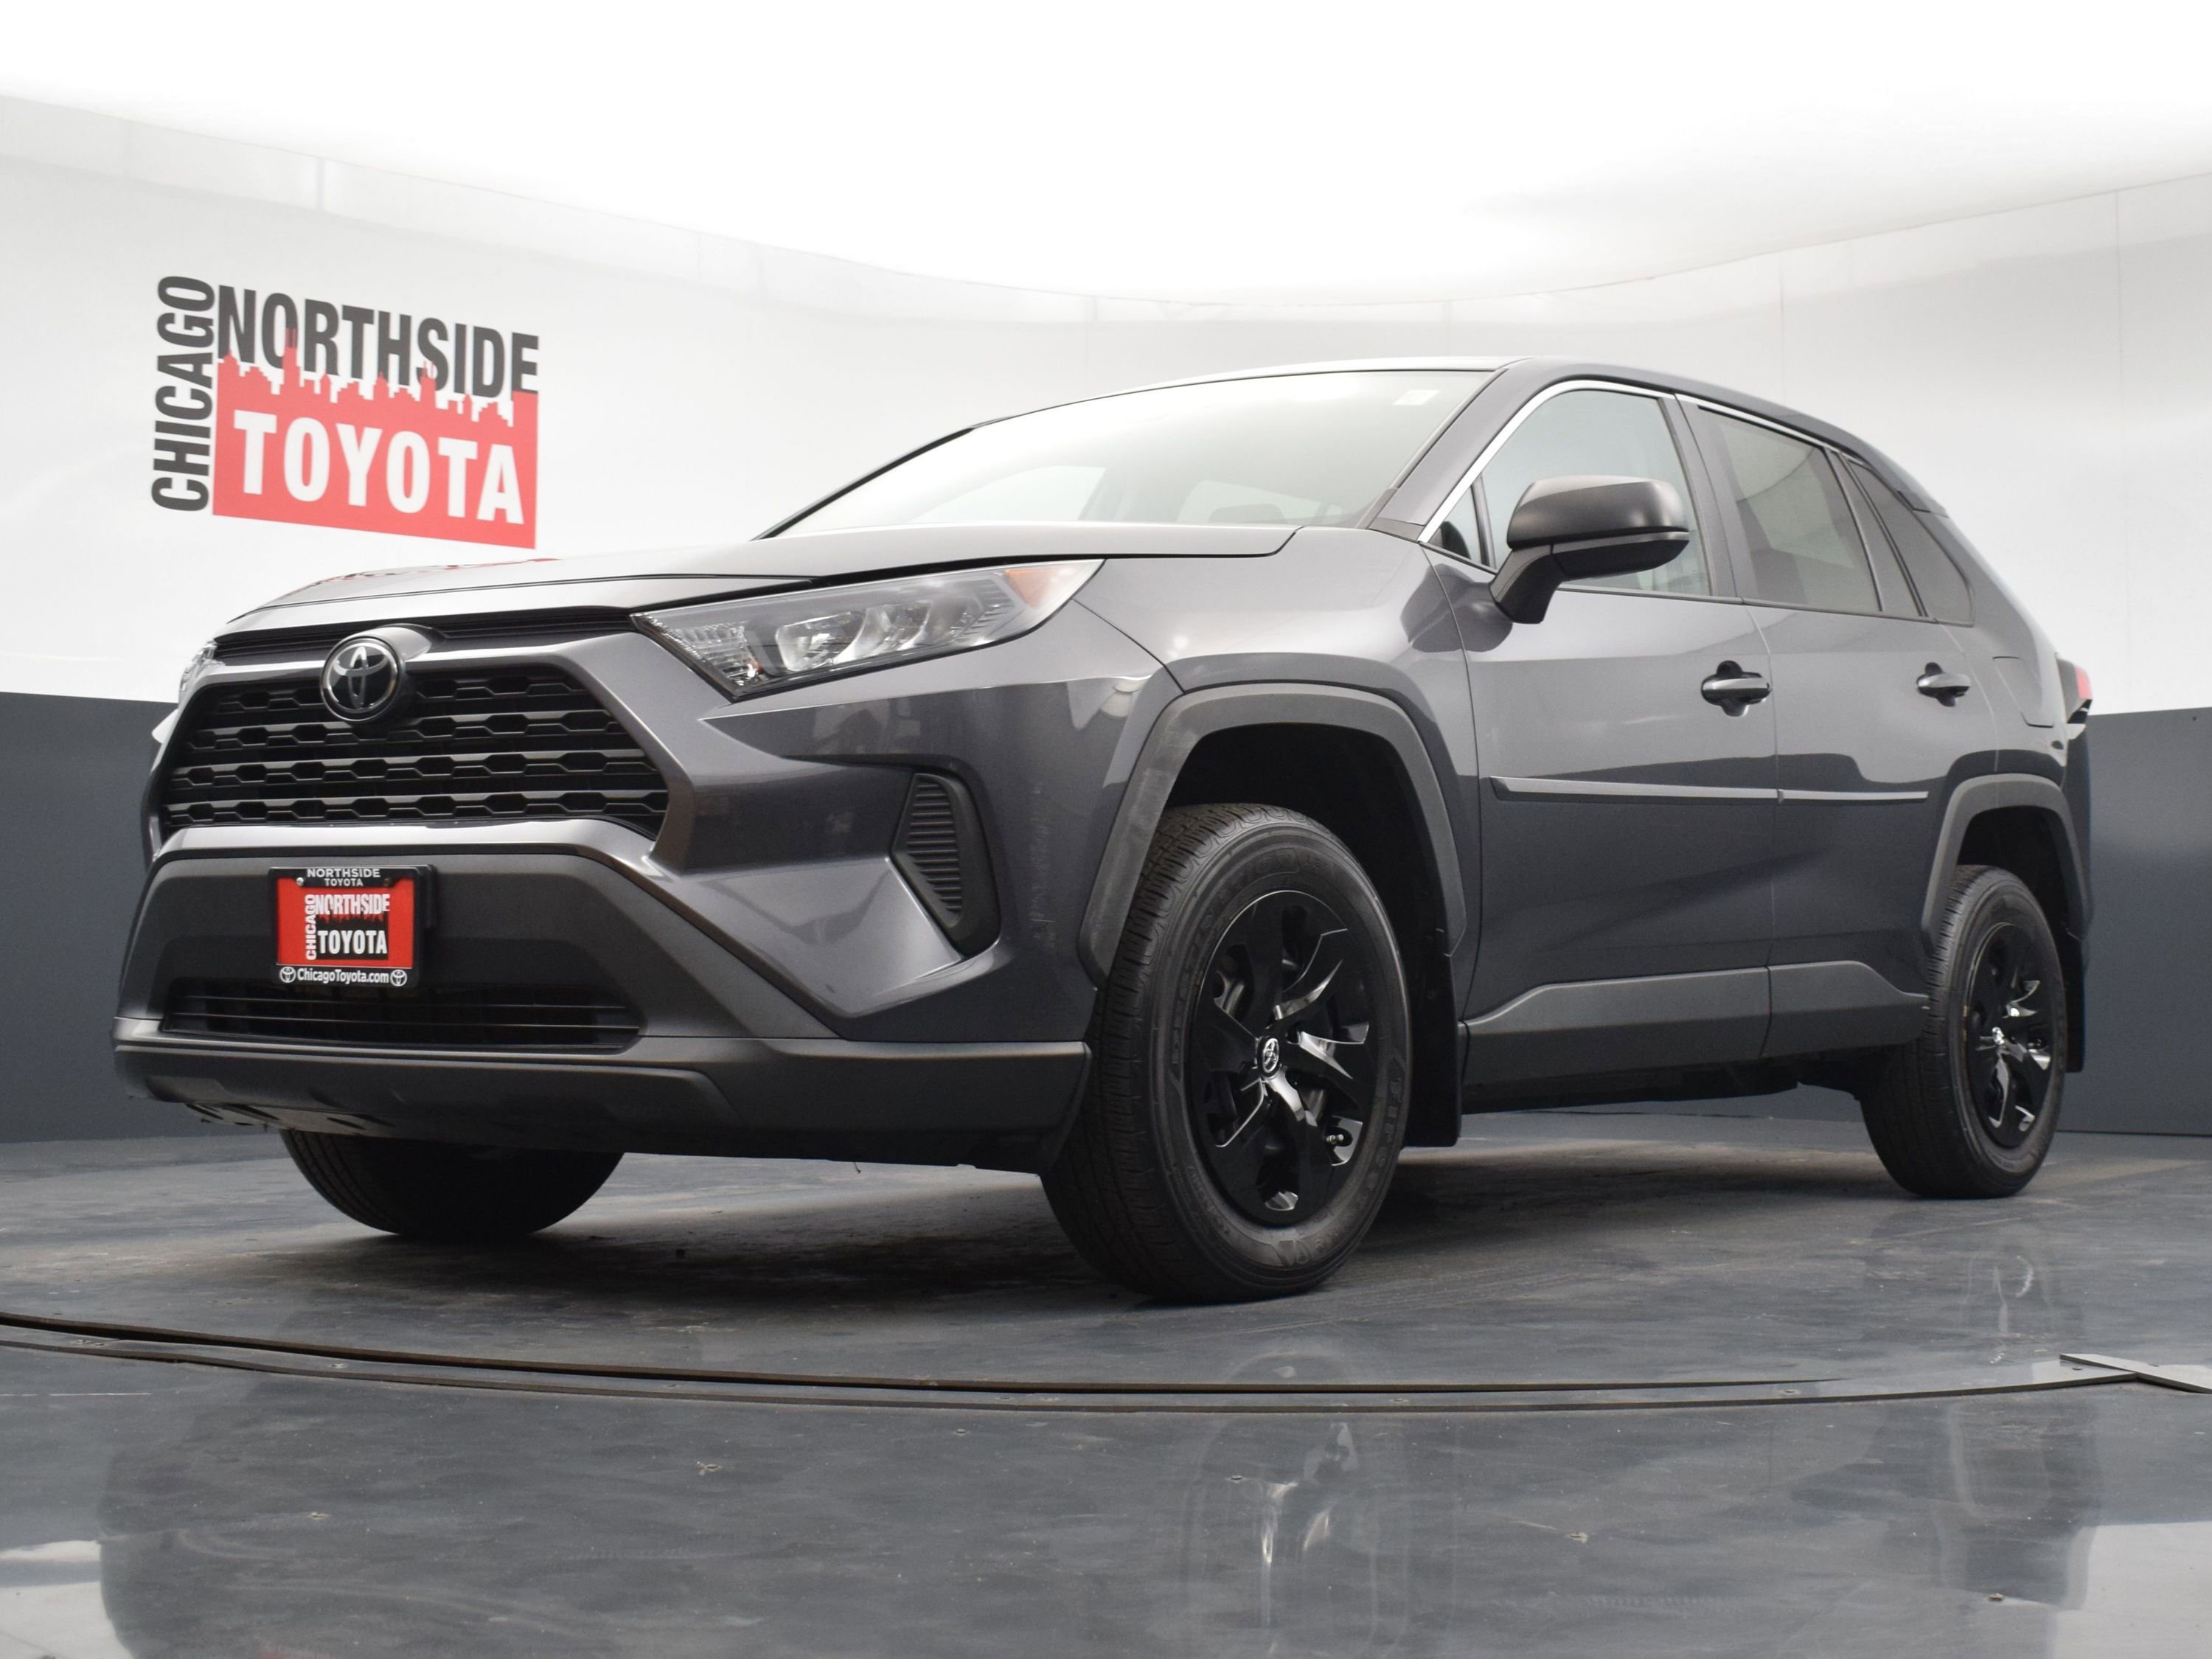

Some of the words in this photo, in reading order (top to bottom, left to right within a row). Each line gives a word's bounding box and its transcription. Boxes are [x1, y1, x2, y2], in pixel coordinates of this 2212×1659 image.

[218, 285, 539, 400] NORTHSIDE
[151, 276, 215, 512] CHICAGO
[233, 409, 524, 524] TOYOTA
[307, 869, 381, 878] NORTHSIDE
[324, 878, 364, 887] TOYOTA
[316, 894, 391, 915] NORTHSIDE
[305, 894, 317, 960] CHICAGO
[318, 930, 388, 954] TOYOTA
[297, 967, 389, 985] ChicagoToyota.com
